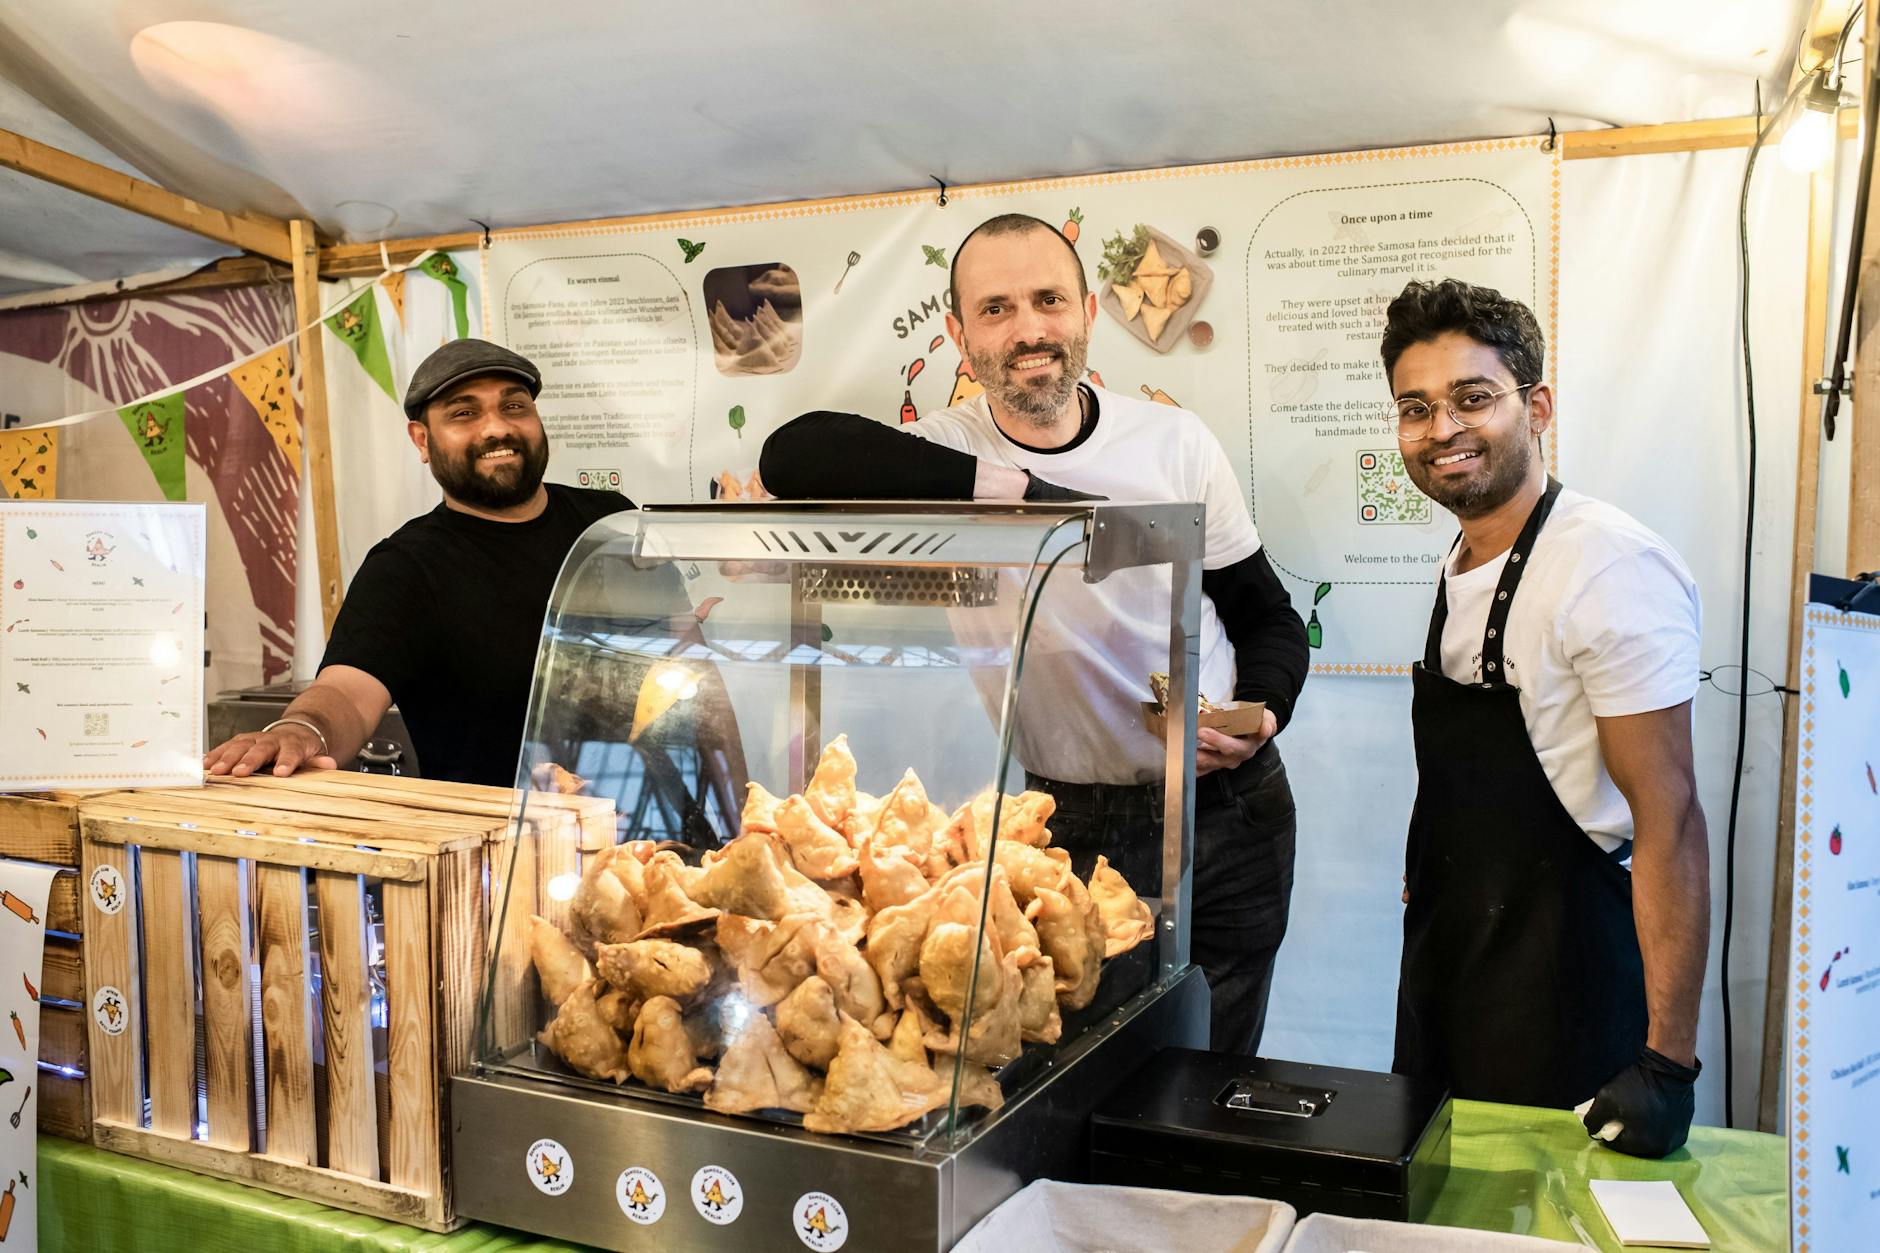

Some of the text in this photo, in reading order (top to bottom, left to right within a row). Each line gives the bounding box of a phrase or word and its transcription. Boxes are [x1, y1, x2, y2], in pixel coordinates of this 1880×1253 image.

[1341, 215, 1367, 225] Once
[1370, 213, 1397, 224] upon
[1409, 210, 1433, 220] time
[1309, 247, 1319, 256] in
[1322, 245, 1346, 255] 2022
[1349, 243, 1375, 253] three
[1378, 241, 1415, 251] Samosa
[1418, 239, 1439, 248] fans
[1441, 234, 1481, 246] decided
[1484, 233, 1505, 244] that
[1508, 233, 1515, 242] it
[1267, 246, 1512, 270] was about time the Samosa got recognised for the
[1337, 267, 1377, 277] culinary
[1380, 264, 1414, 274] marvel
[1417, 263, 1424, 272] it
[576, 277, 597, 285] waren
[598, 275, 620, 283] einmal
[609, 297, 625, 306] 2022
[1281, 300, 1305, 311] They
[1307, 300, 1332, 308] were
[1334, 297, 1361, 308] upset
[1363, 296, 1373, 305] at
[639, 305, 679, 313] Wunderwerk
[1266, 306, 1384, 321] delicious and loved back
[1279, 322, 1313, 333] treated
[1316, 320, 1337, 331] with
[1340, 319, 1363, 329] such
[1365, 320, 1371, 328] a
[1346, 331, 1382, 341] restaur
[1264, 359, 1380, 375] They decided to make it
[1346, 371, 1383, 381] make it
[1271, 403, 1298, 413] Come
[1300, 402, 1324, 412] taste
[1326, 401, 1342, 411] the
[1344, 400, 1385, 411] delicacy
[1291, 410, 1388, 424] traditions, rich with
[1315, 426, 1391, 437] handmade to cr
[1344, 553, 1388, 564] Welcome
[1391, 555, 1400, 564] to
[1403, 553, 1419, 564] the
